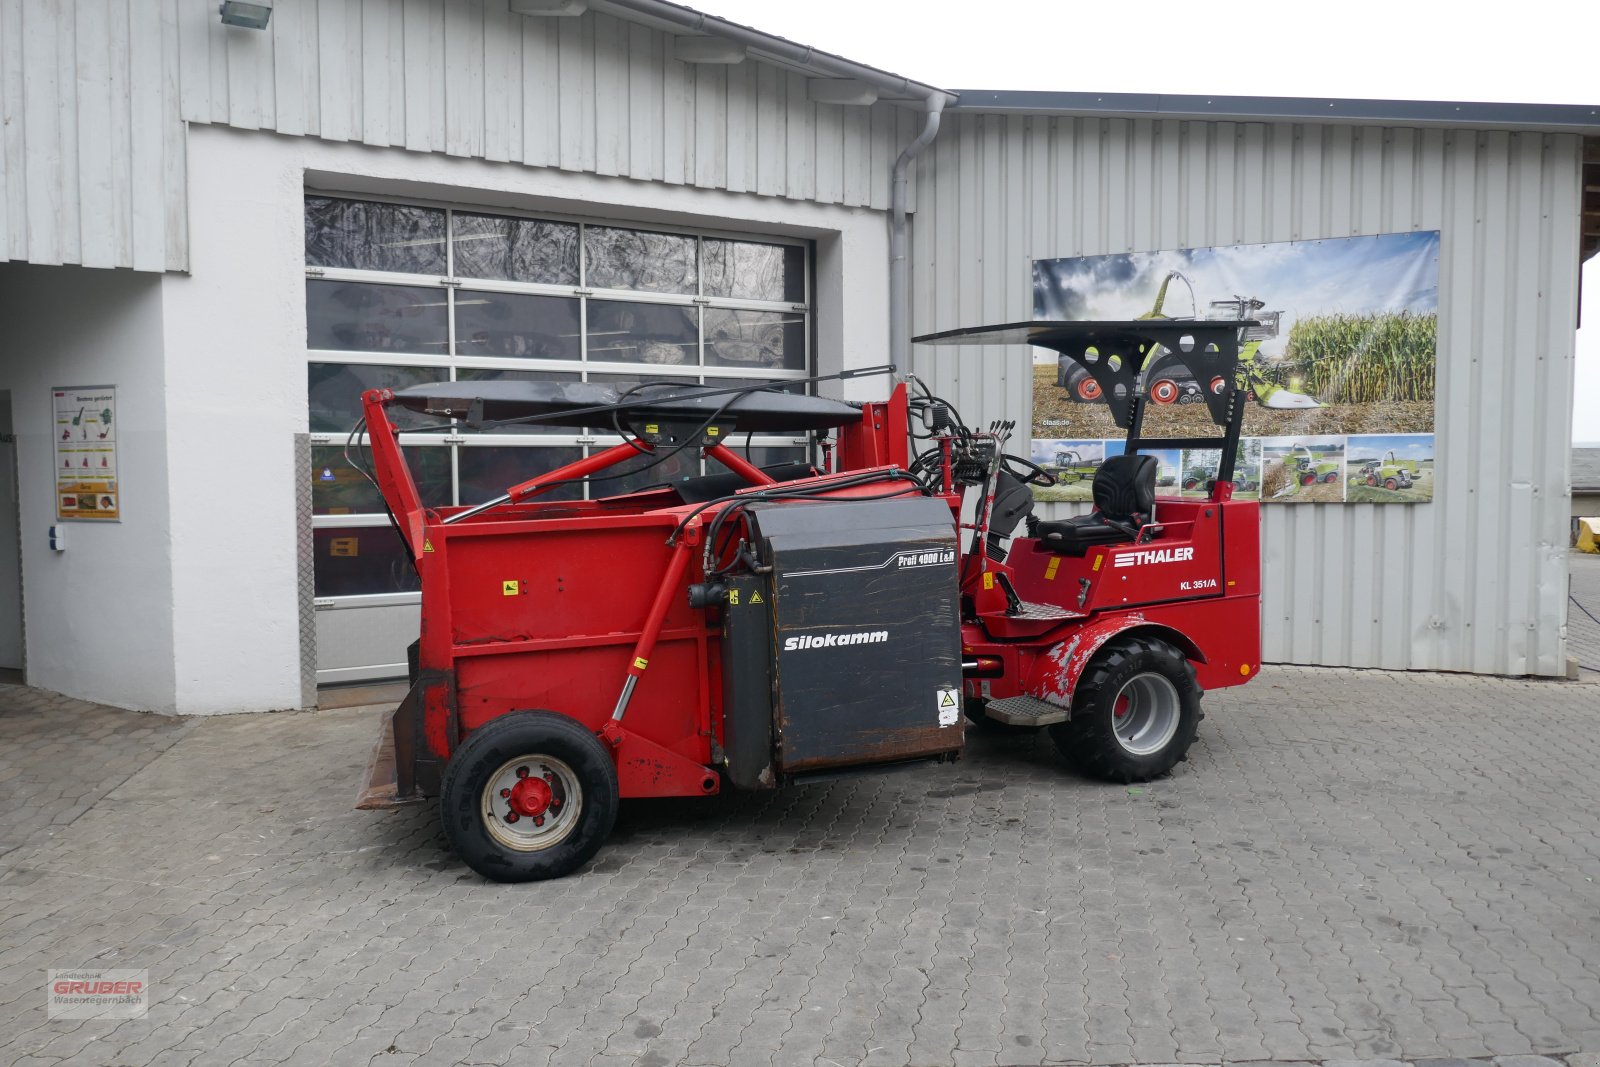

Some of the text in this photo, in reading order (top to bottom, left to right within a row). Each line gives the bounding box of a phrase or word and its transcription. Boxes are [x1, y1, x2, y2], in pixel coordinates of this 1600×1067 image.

[898, 555, 917, 567] Profi
[918, 553, 938, 565] 4000
[1134, 547, 1194, 566] THALER
[1180, 579, 1217, 590] KL 351/A
[784, 630, 889, 651] Silokamm
